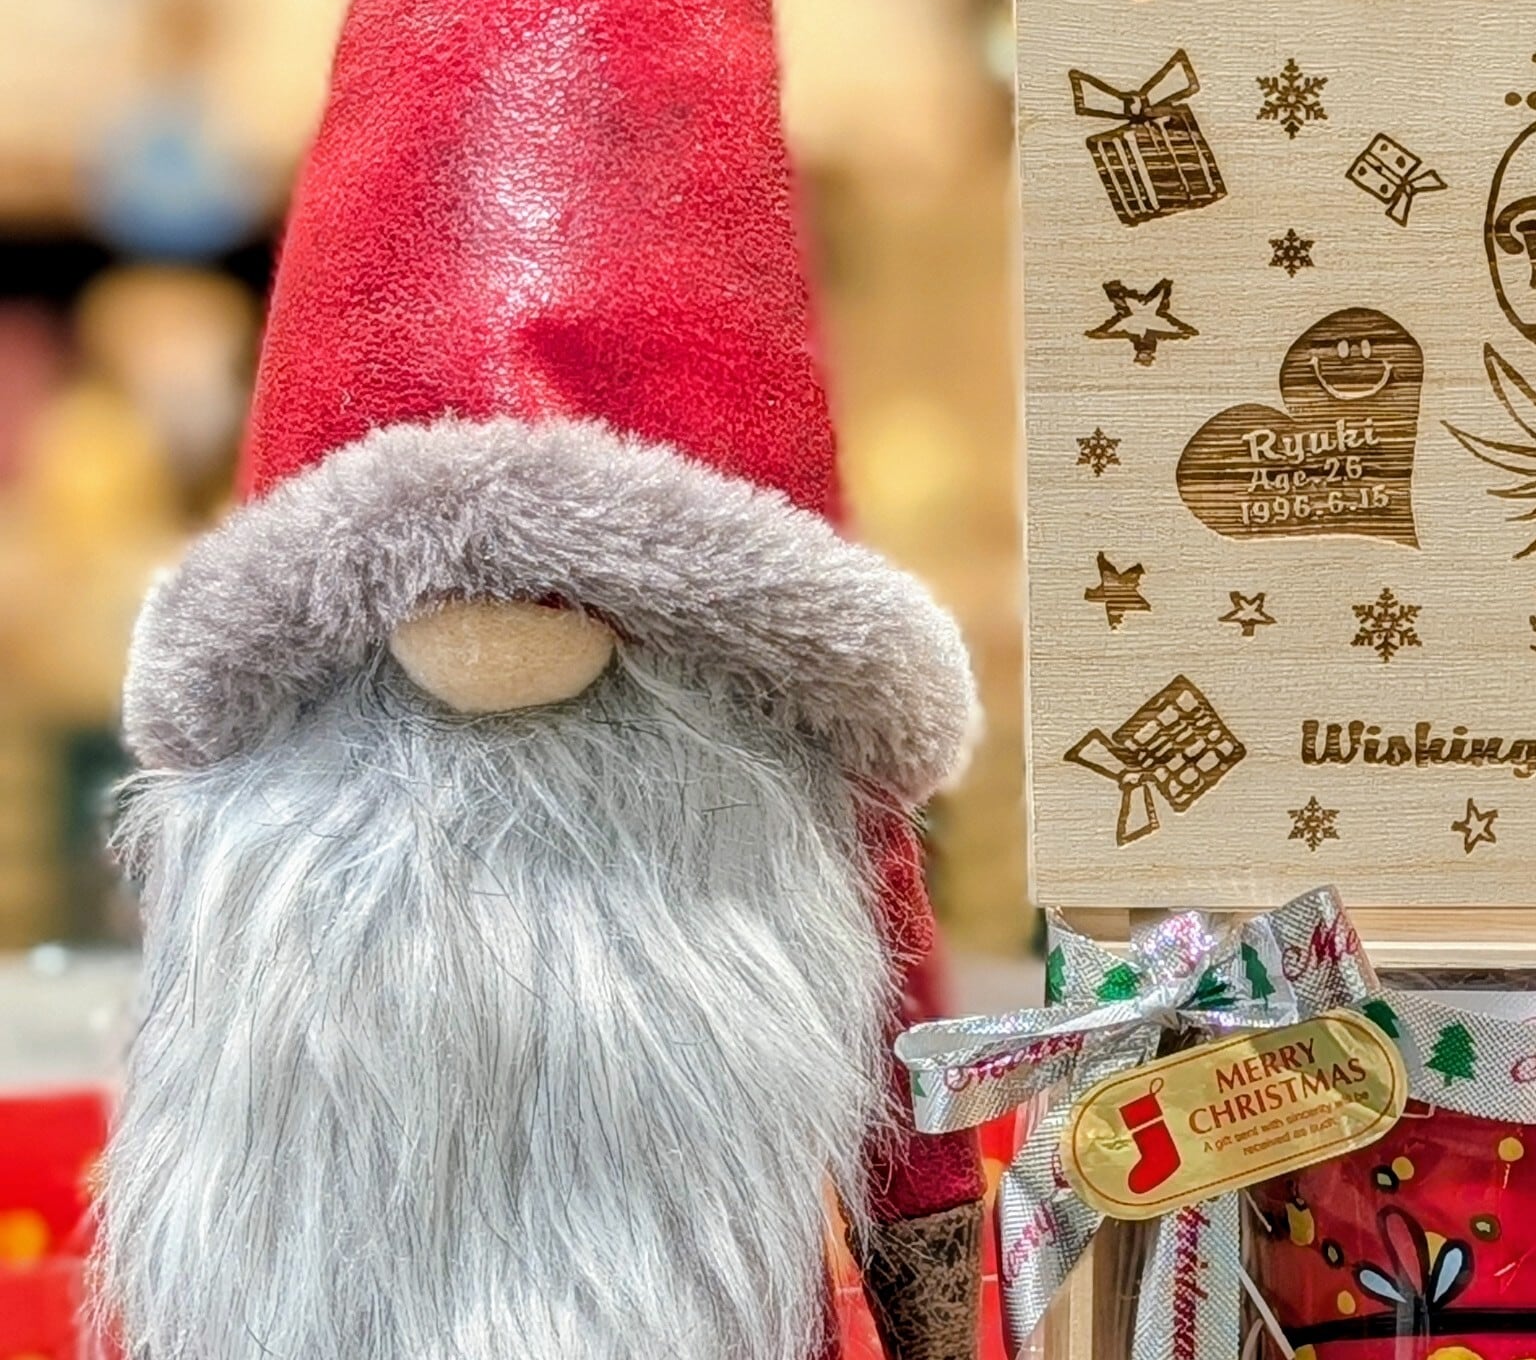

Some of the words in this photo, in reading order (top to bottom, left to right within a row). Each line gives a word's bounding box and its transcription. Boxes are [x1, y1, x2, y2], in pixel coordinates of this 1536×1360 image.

[1242, 417, 1380, 464] Ryuki
[1241, 483, 1390, 525] 1996.6.15
[1216, 1037, 1316, 1094] MERRY
[1188, 1056, 1367, 1135] CHRISTMAS
[1203, 1141, 1214, 1153] A
